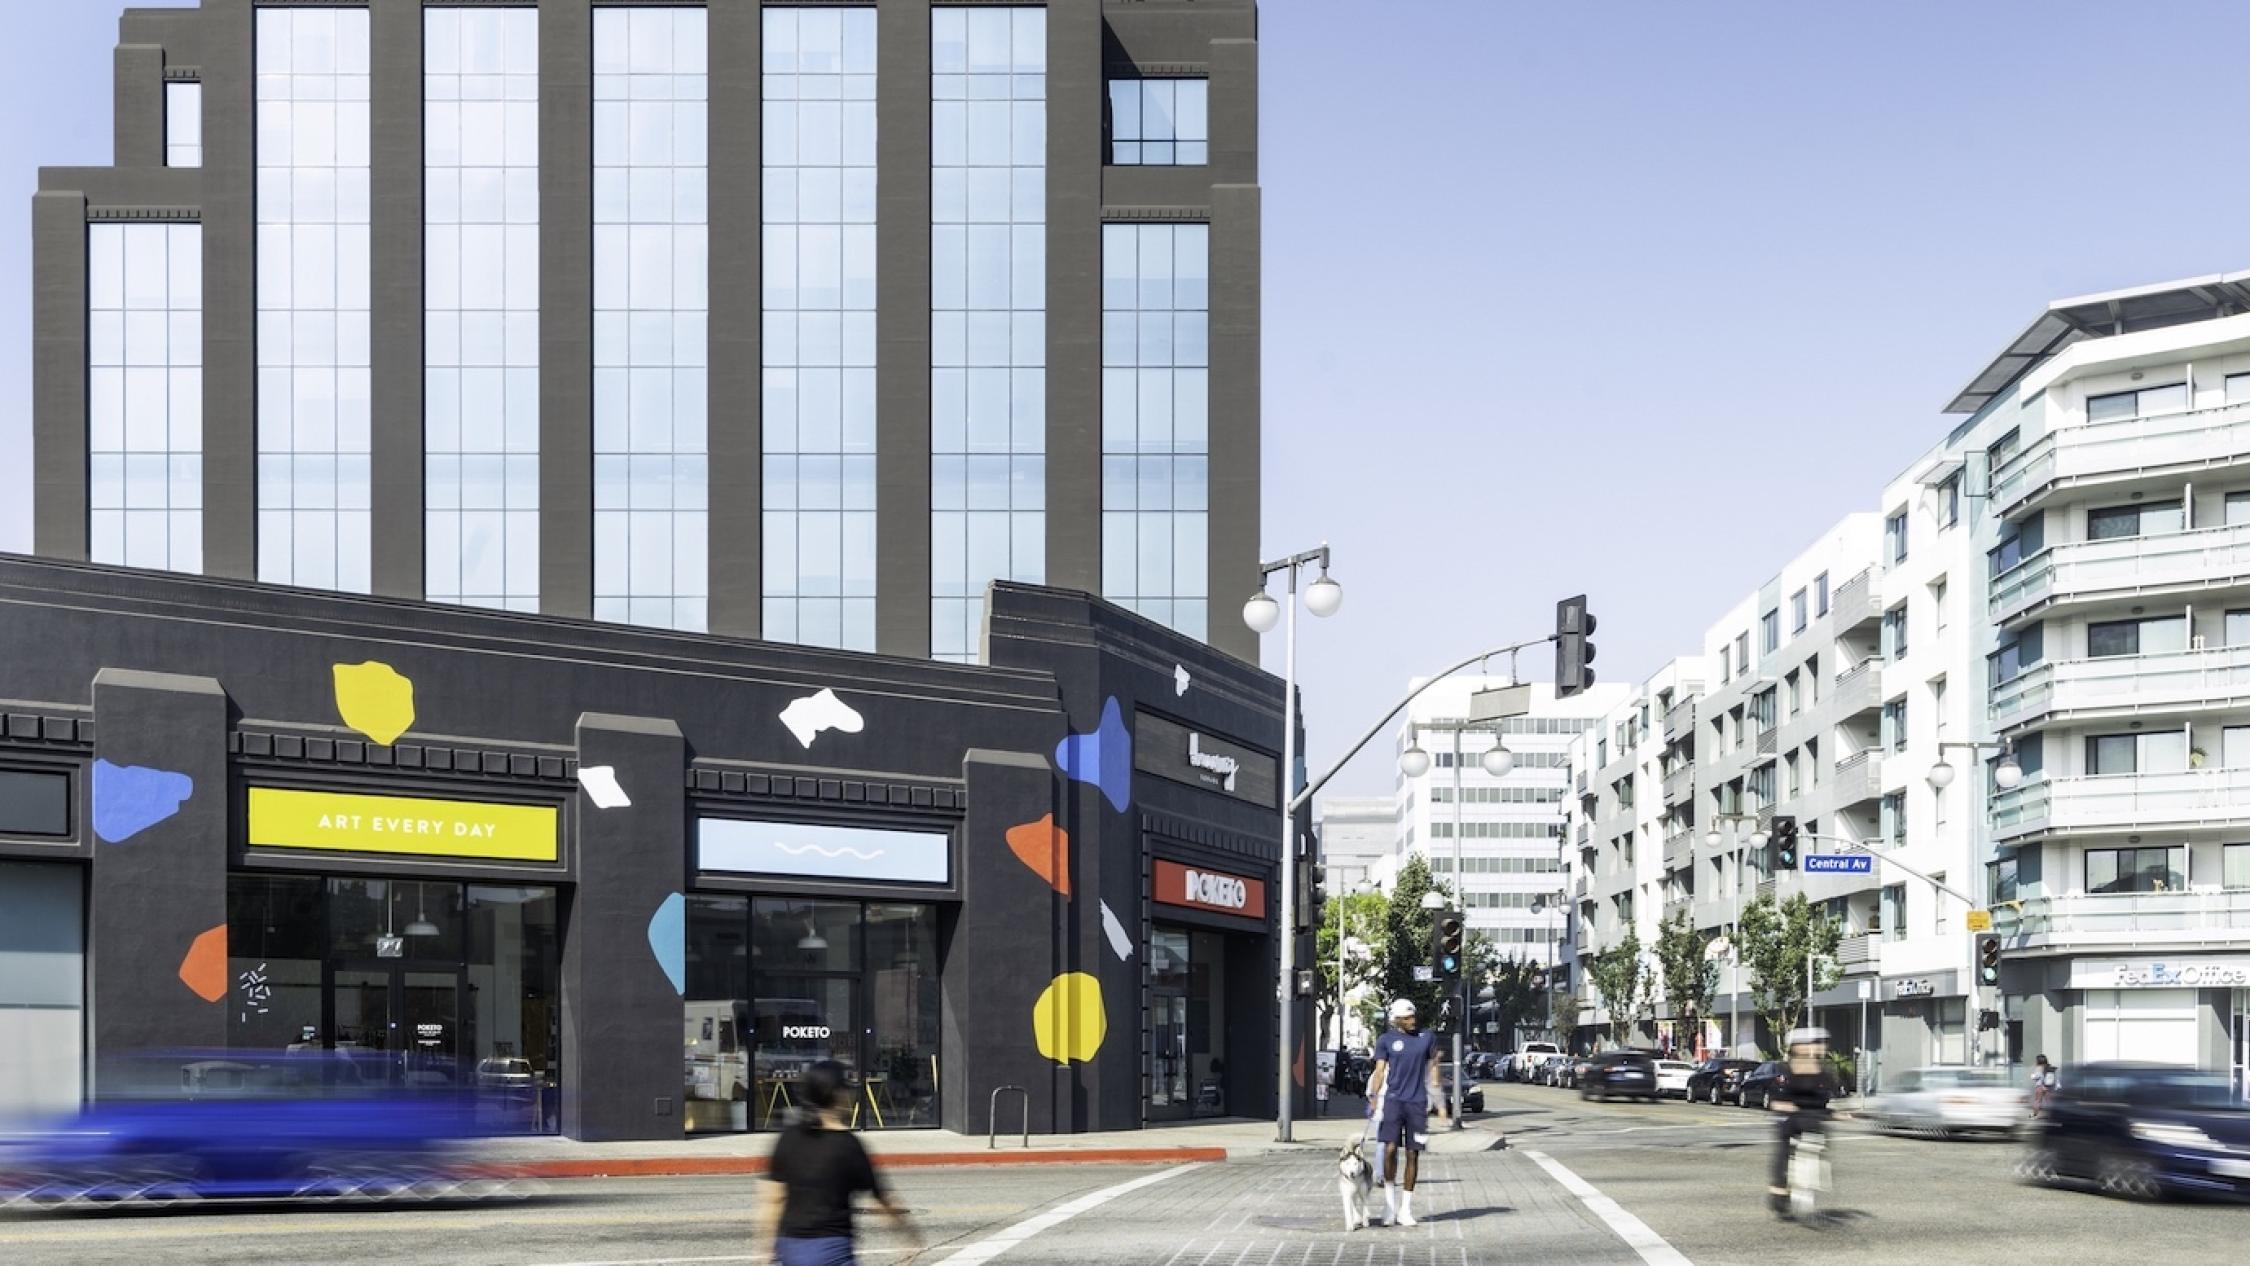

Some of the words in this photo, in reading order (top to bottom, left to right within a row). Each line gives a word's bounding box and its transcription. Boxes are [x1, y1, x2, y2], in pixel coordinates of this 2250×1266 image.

[318, 814, 361, 830] ART
[372, 817, 444, 835] EVERY
[454, 822, 496, 838] DAY
[1808, 858, 1849, 869] Central
[1852, 858, 1867, 869] Av
[1185, 869, 1246, 909] POKETO
[2183, 964, 2247, 985] Office
[782, 1025, 831, 1039] POKETO
